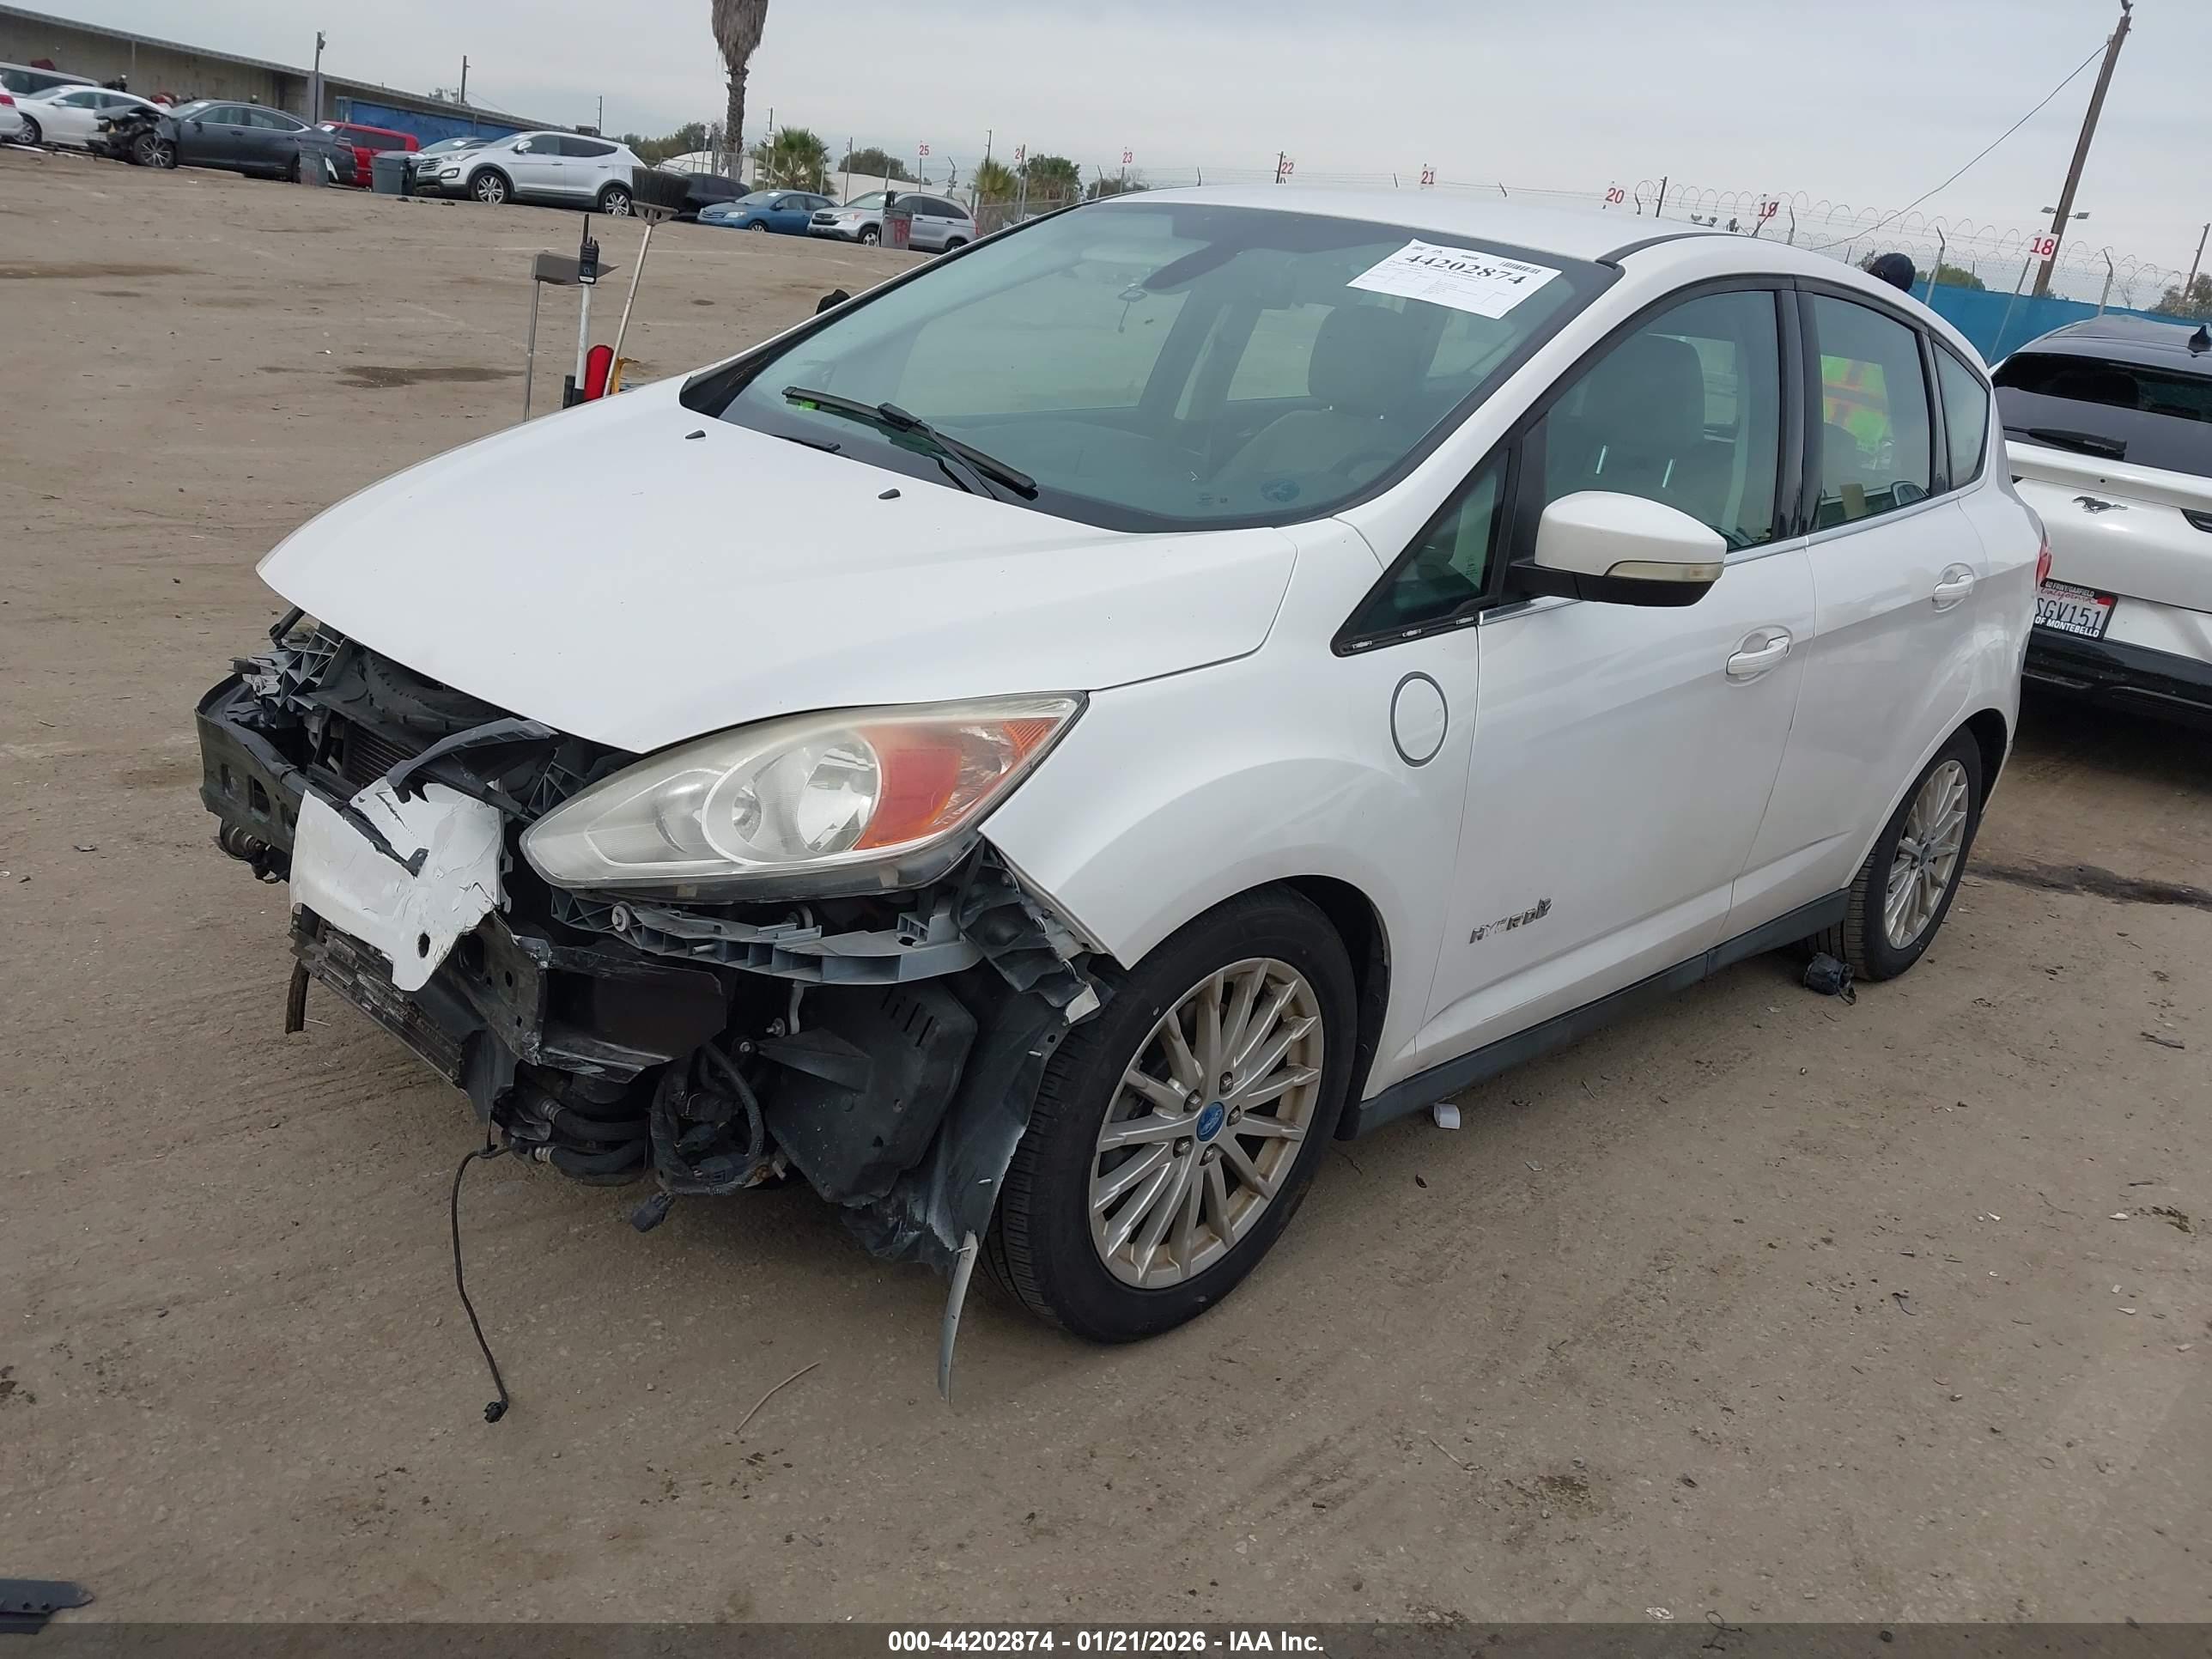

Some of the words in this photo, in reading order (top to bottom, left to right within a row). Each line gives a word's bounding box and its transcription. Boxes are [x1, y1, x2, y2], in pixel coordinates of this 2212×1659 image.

[919, 144, 929, 156] 25
[1122, 151, 1133, 164] 23
[1281, 161, 1294, 174] 22
[1421, 170, 1435, 185] 21
[1605, 187, 1625, 204] 20
[1758, 201, 1778, 217] 19
[2030, 237, 2055, 256] 18
[1405, 254, 1528, 285] 44202874
[2035, 616, 2047, 624] OF
[2047, 619, 2100, 638] MONTEBELLO
